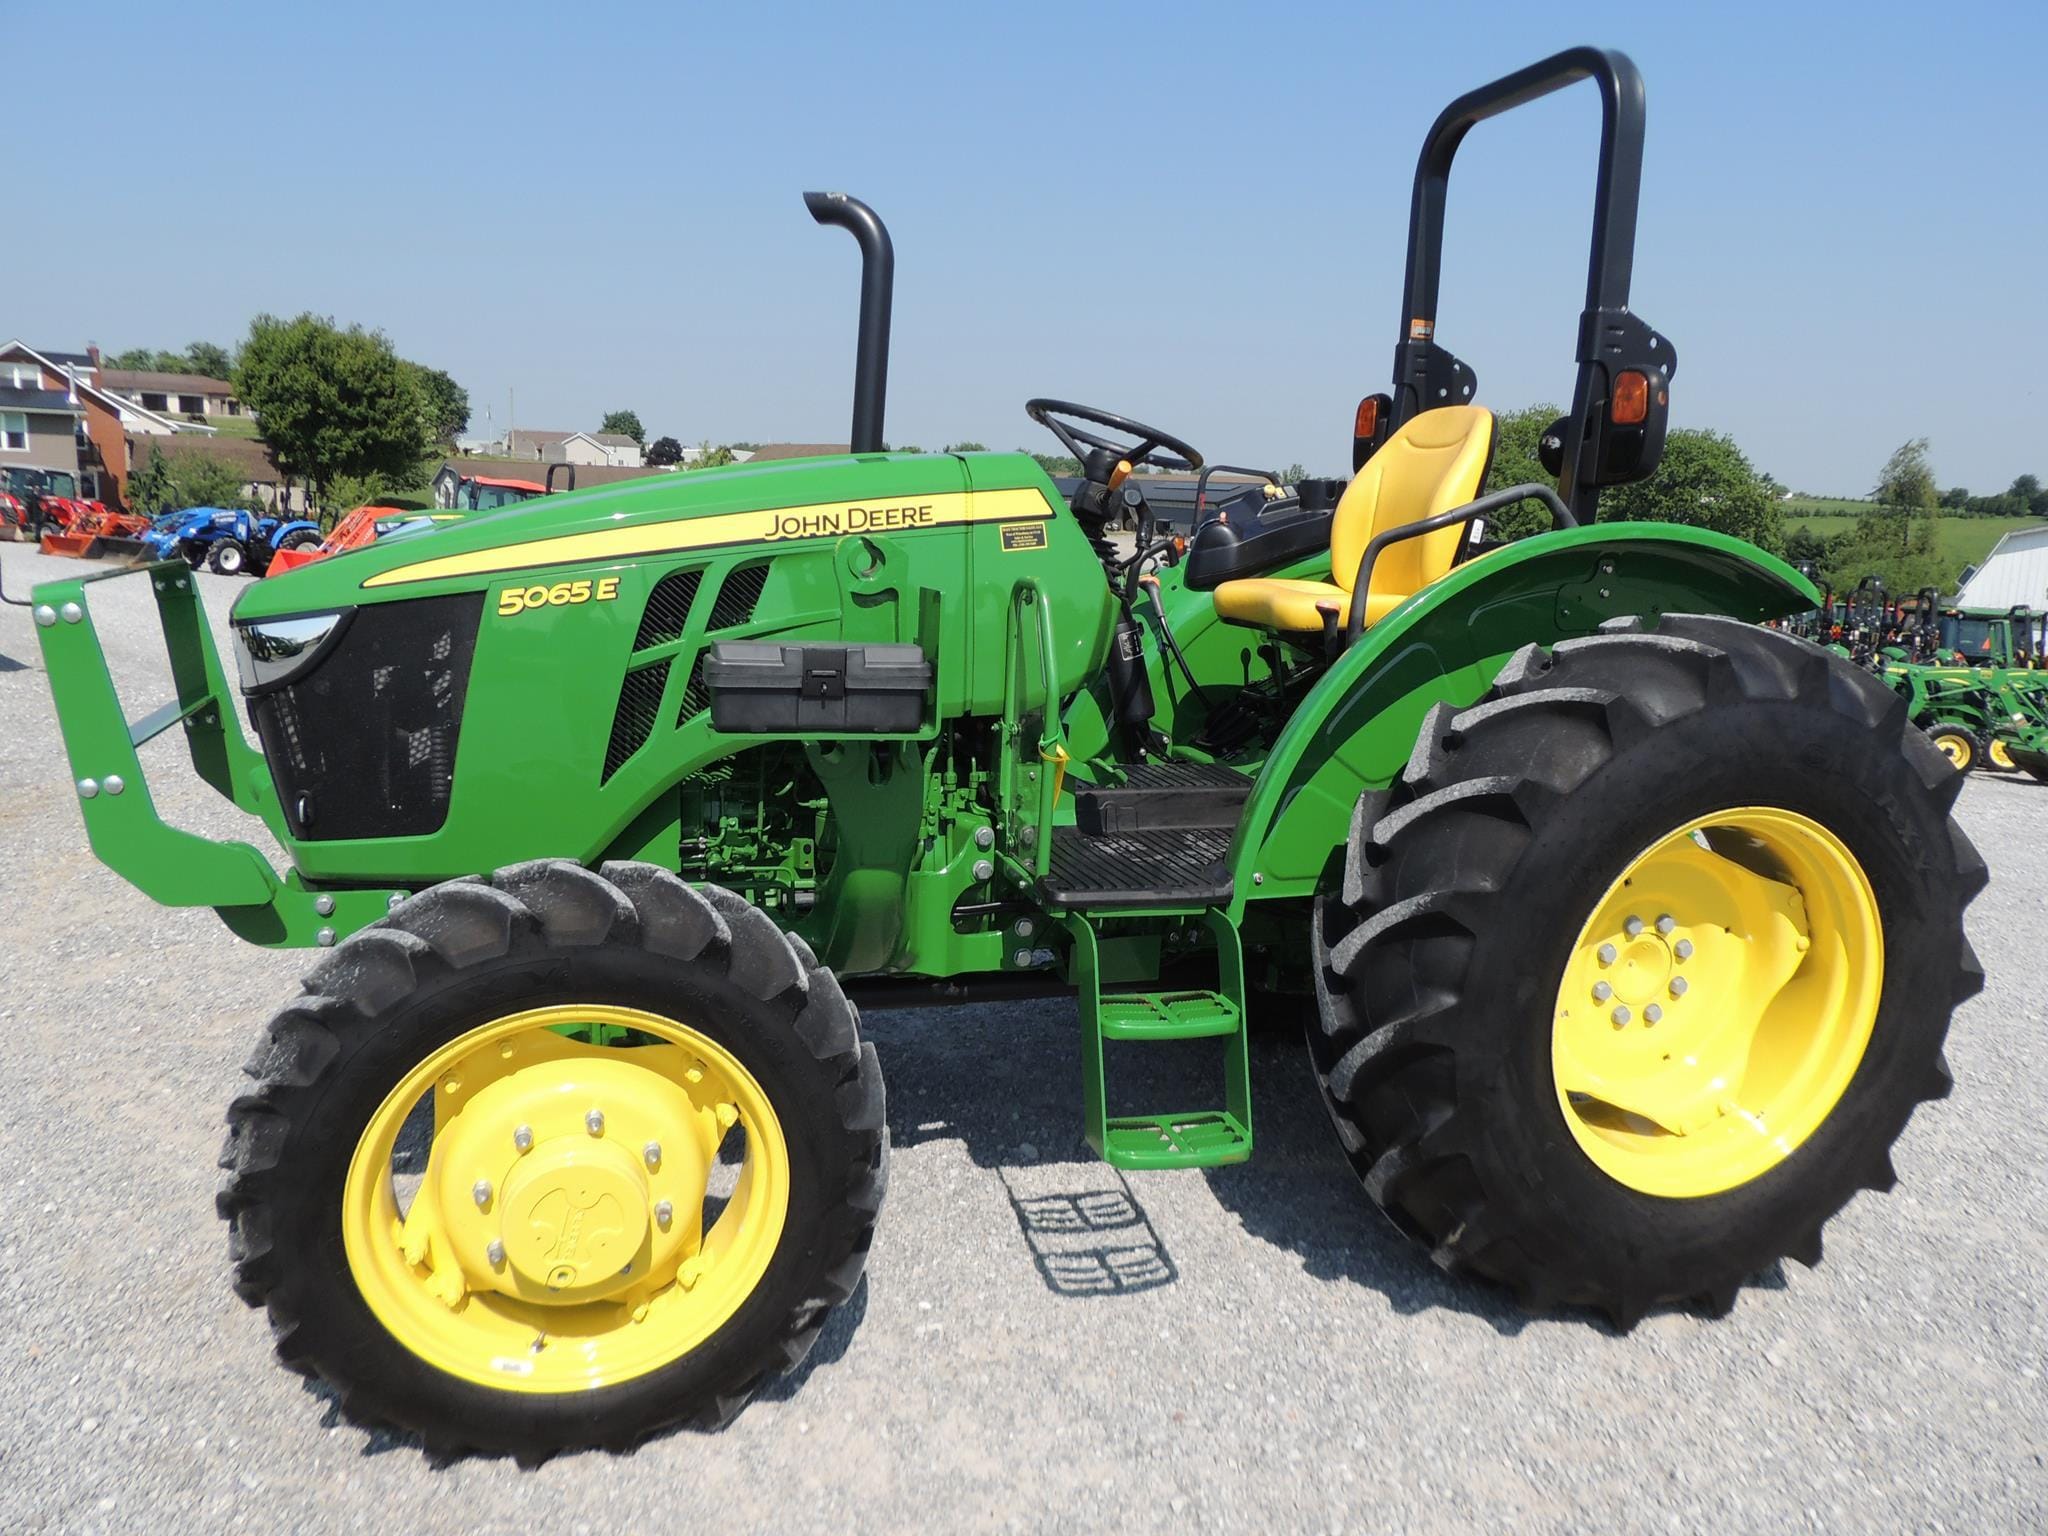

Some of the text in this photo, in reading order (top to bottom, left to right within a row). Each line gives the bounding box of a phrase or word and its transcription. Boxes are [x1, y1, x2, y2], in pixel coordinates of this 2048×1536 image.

[764, 505, 934, 537] JOHN DEERE
[498, 577, 621, 616] 5065 E
